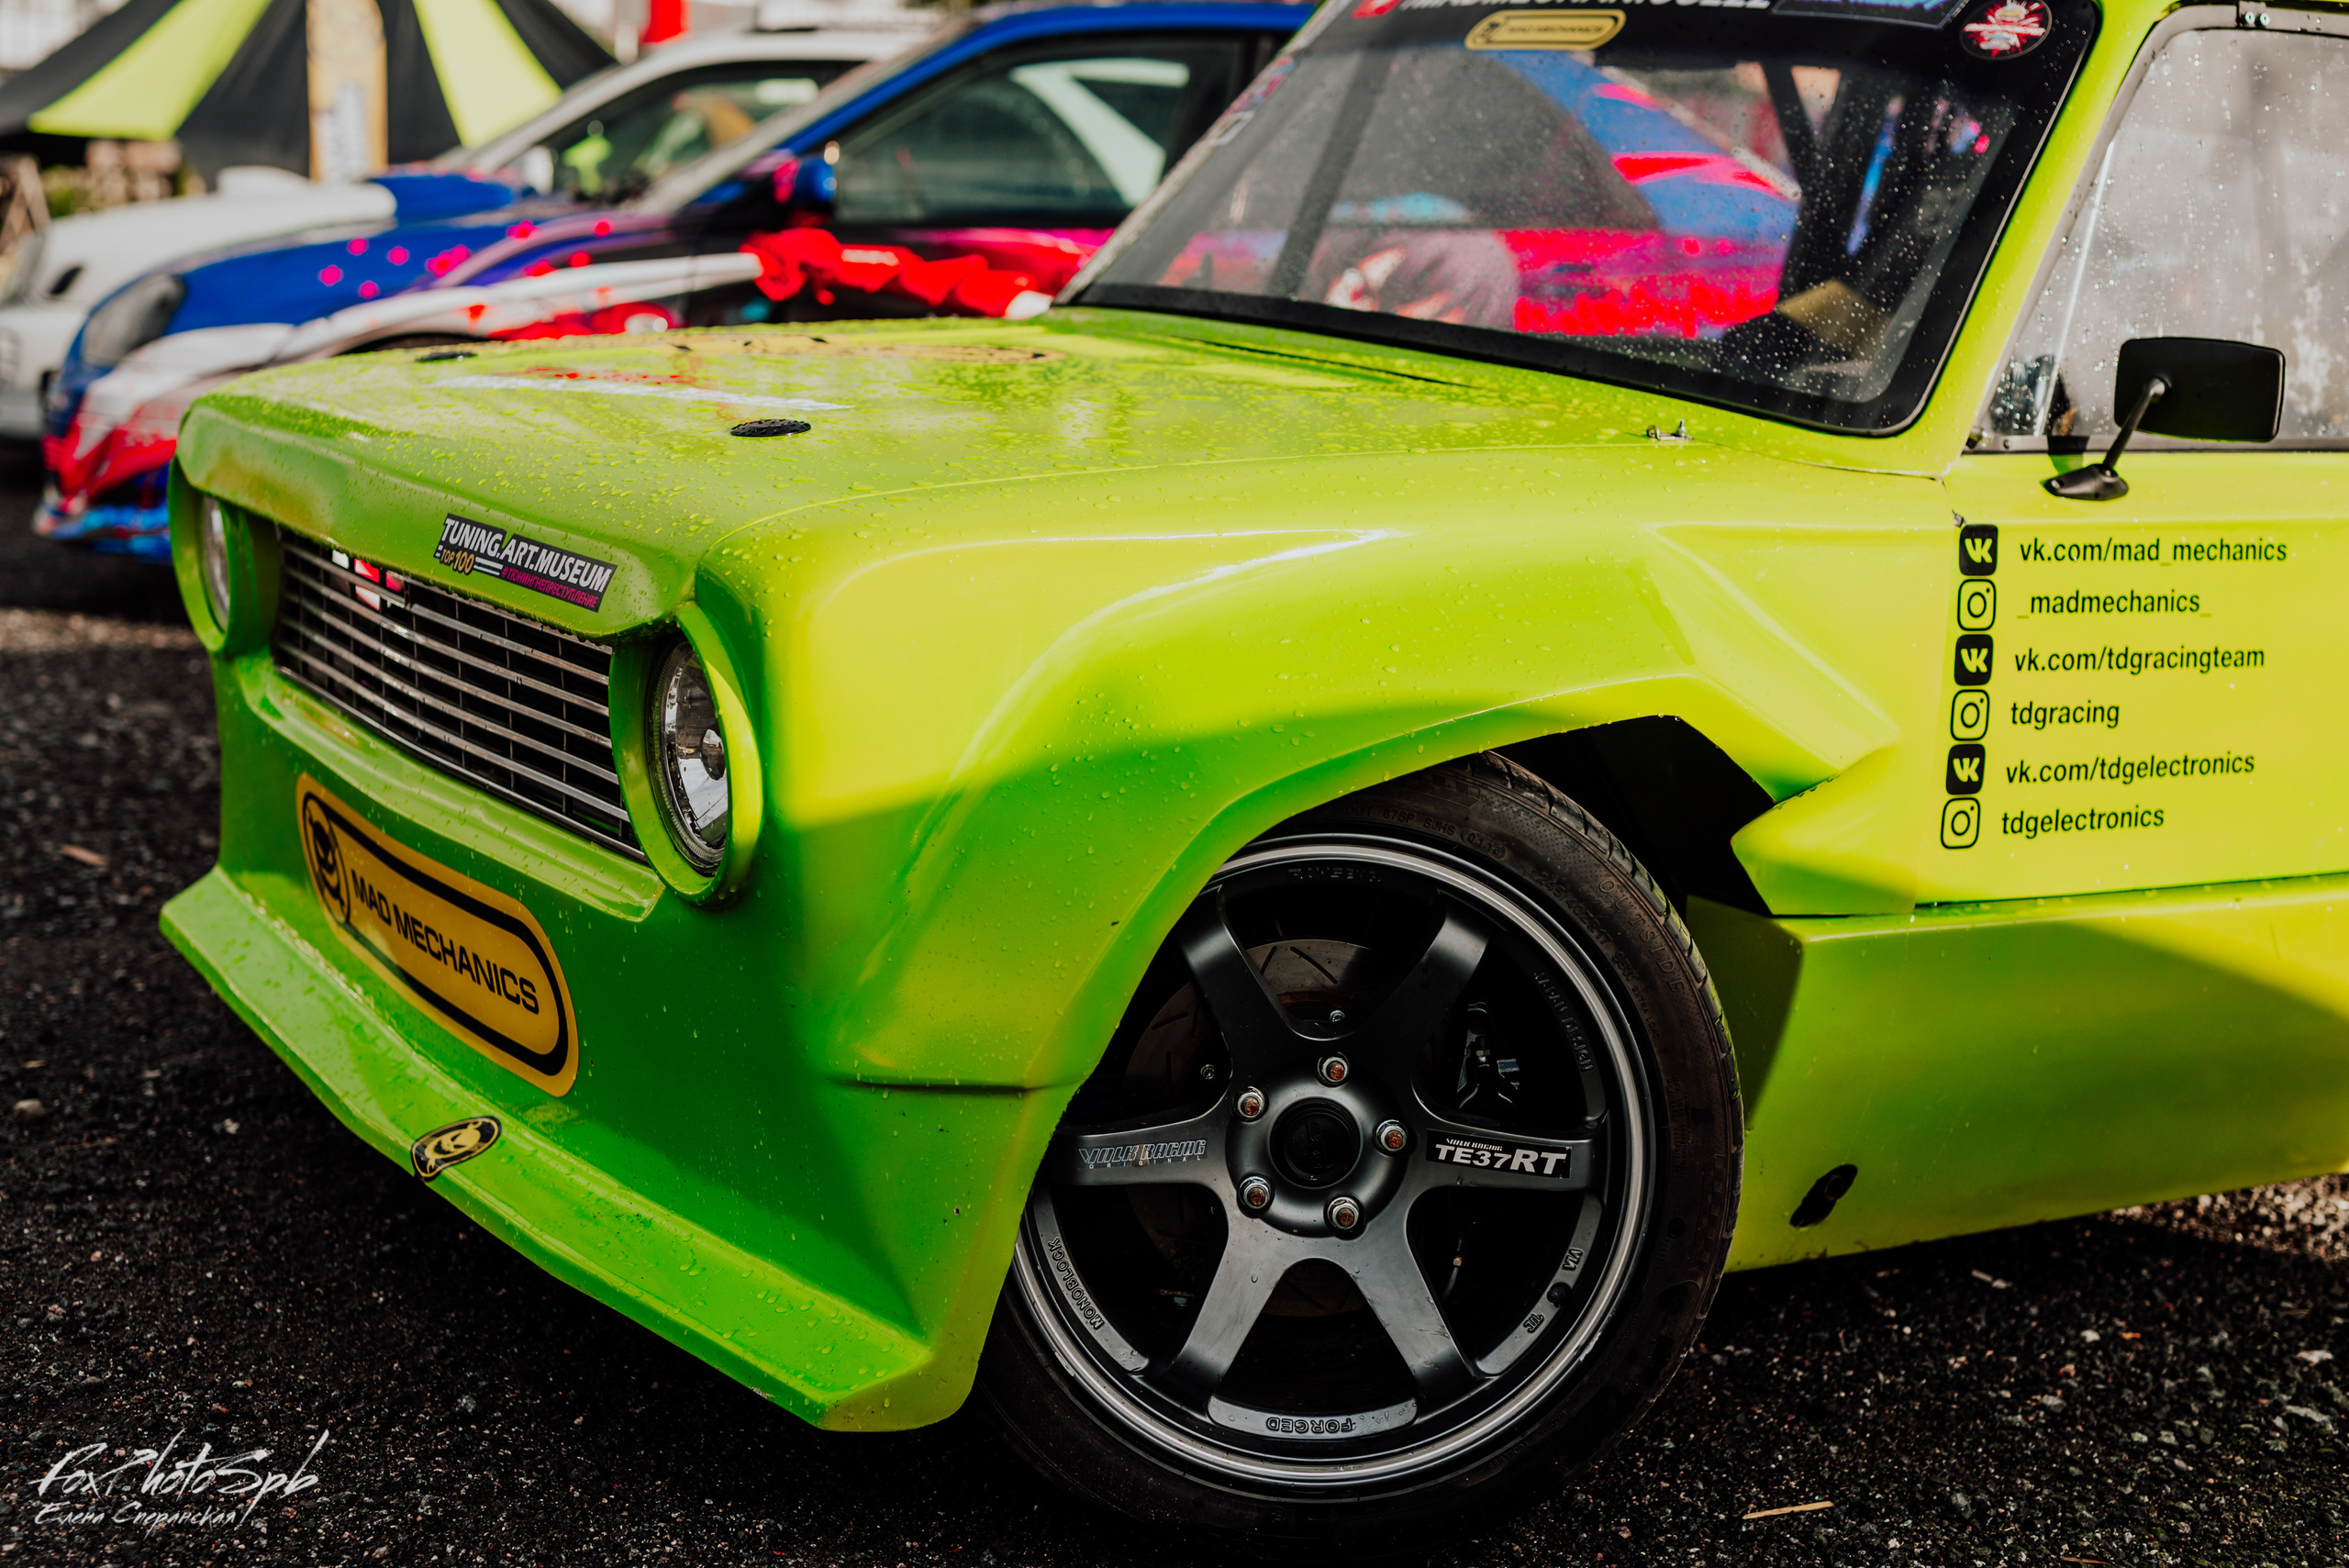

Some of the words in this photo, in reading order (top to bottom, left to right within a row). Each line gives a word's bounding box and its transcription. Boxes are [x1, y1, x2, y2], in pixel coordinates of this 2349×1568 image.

[440, 517, 613, 593] TUNING.ART.MUSEUM
[440, 549, 455, 563] TOP
[452, 551, 475, 574] 100
[2020, 538, 2288, 567] vk.com/mad_mechanics
[2017, 588, 2211, 617] _madmechanics_
[2014, 645, 2266, 675] vk.com/tdgracingteam
[2010, 700, 2121, 730] tdgracing
[2006, 750, 2254, 784] vk.com/tdgelectronics
[1345, 805, 1373, 817] DOT
[2001, 805, 2165, 840] tdgelectronics
[351, 868, 392, 928] MAD
[392, 903, 540, 1016] MECHANICS
[1599, 879, 1686, 993] OUTSIDE
[1533, 971, 1569, 1015] JAPAN
[1561, 1016, 1595, 1073] DESIGN
[1088, 1155, 1202, 1170] ORIGINAL
[1141, 1140, 1207, 1161] RACING
[1047, 1236, 1105, 1330] MONOBLOCK
[1266, 1417, 1354, 1435] FORGED
